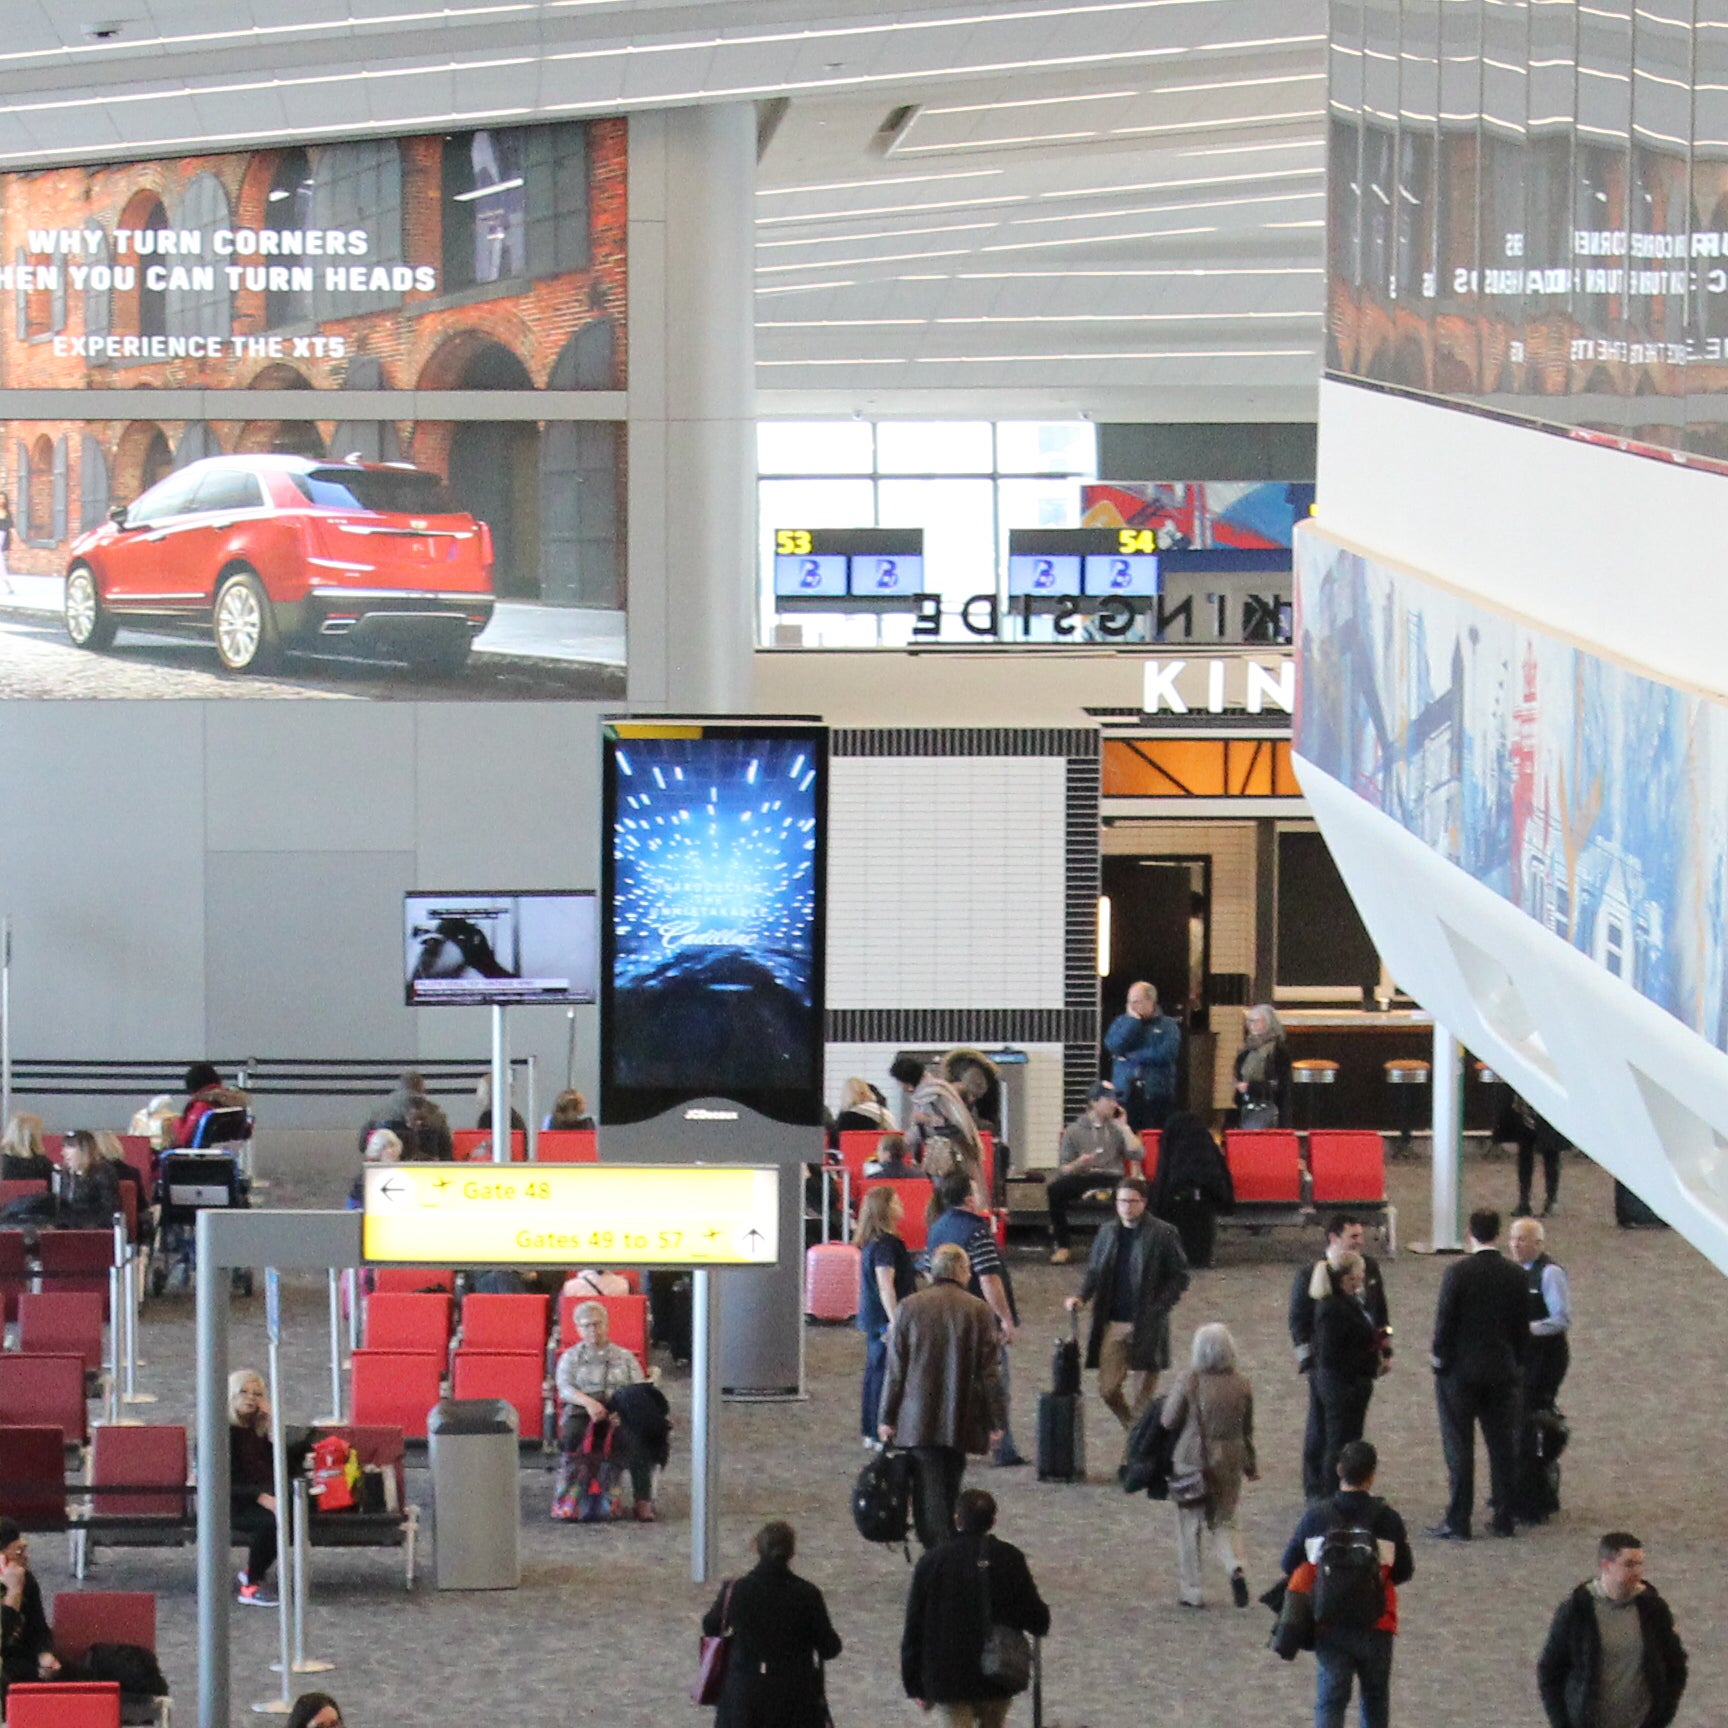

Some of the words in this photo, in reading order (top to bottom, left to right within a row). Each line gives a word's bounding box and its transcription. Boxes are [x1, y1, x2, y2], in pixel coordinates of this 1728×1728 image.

[27, 230, 103, 255] WHY
[113, 230, 202, 255] TURN
[213, 230, 369, 256] CORNERS
[69, 265, 136, 291] YOU
[146, 265, 215, 291] CAN
[225, 265, 314, 291] TURN
[325, 265, 437, 291] HEADS
[52, 336, 222, 358] EXPERIENCE
[232, 336, 283, 358] THE
[293, 336, 346, 358] XT5
[776, 530, 812, 554] 53
[1118, 529, 1156, 553] 54
[658, 920, 759, 949] Cadillac
[462, 1180, 517, 1201] Gate
[523, 1180, 552, 1200] 48
[515, 1229, 580, 1250] Gates
[587, 1229, 615, 1249] 49
[623, 1231, 649, 1249] to
[658, 1230, 685, 1249] 57
